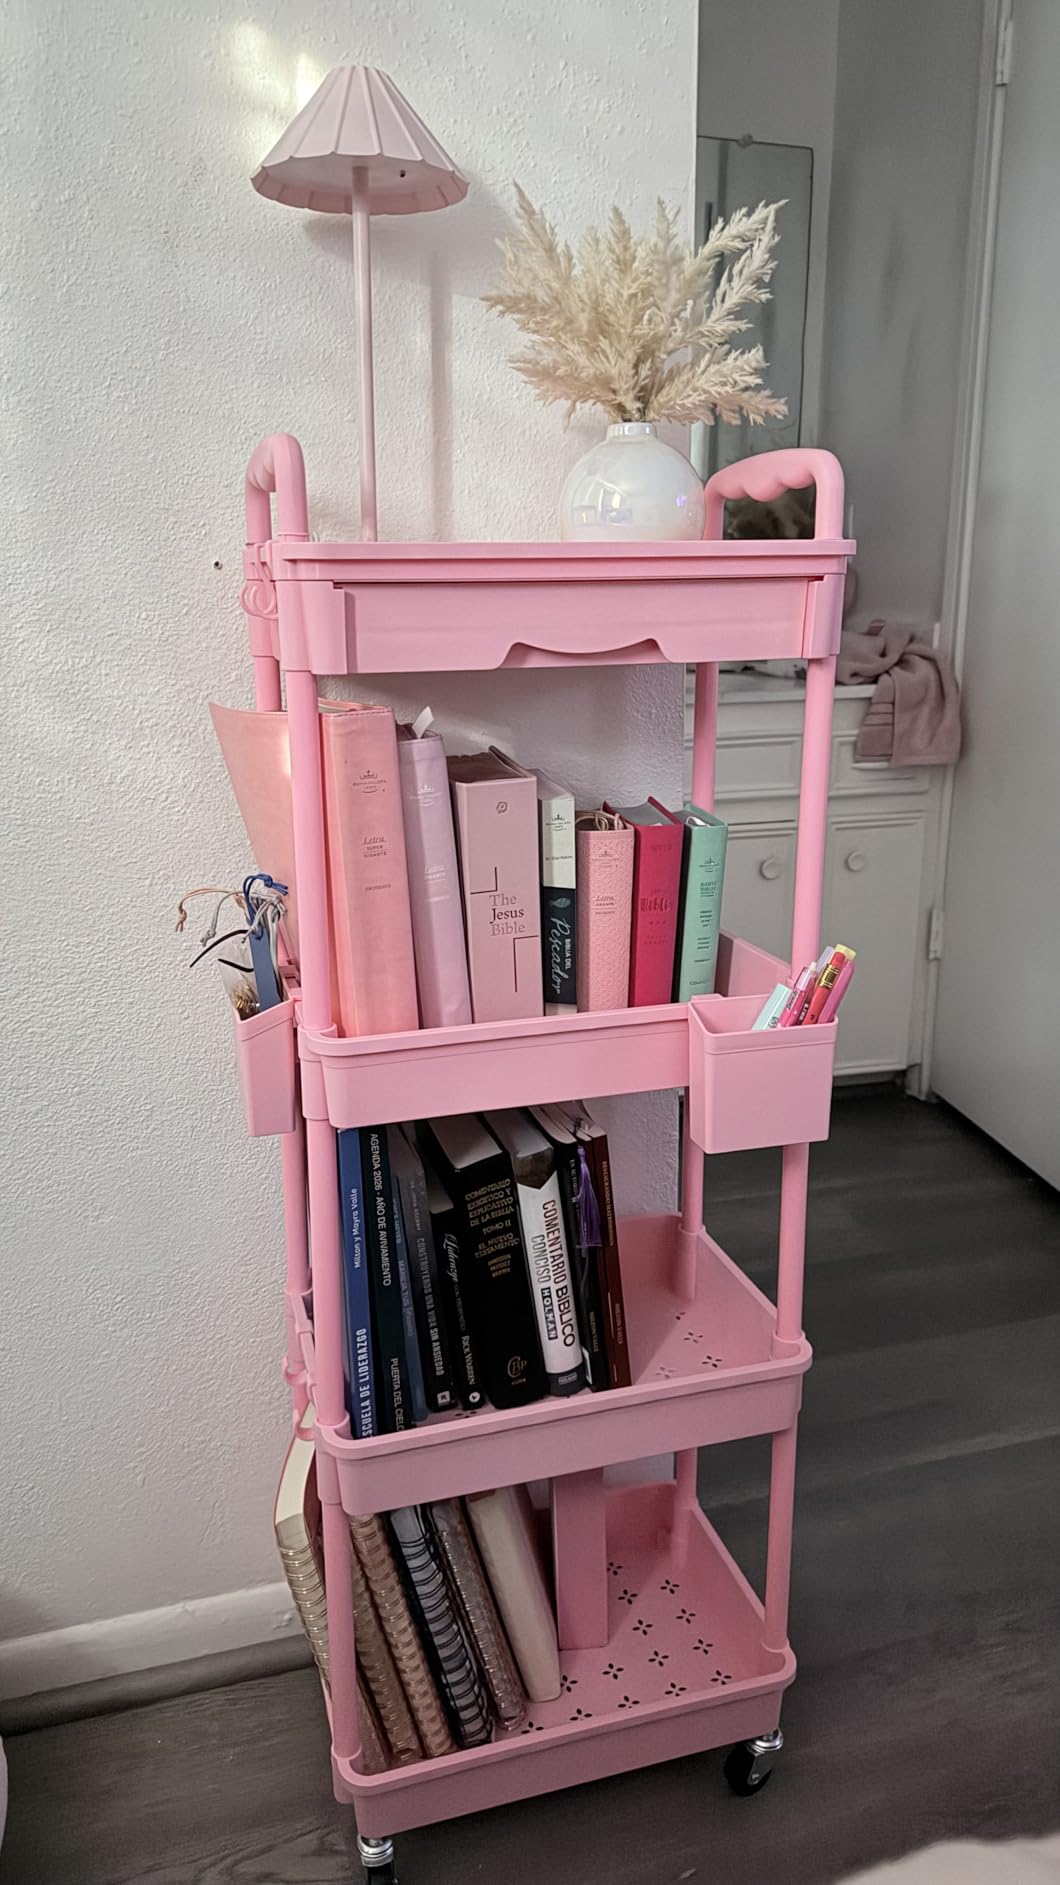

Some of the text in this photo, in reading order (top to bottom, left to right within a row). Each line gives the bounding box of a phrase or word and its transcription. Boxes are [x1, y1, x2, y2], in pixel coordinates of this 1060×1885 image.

[489, 893, 517, 906] The
[489, 908, 525, 924] Jesus
[490, 921, 526, 936] Bible
[549, 917, 571, 995] Pescador
[370, 1133, 381, 1170] AGENDA
[373, 1171, 382, 1190] 2026
[465, 1179, 511, 1201] COMENTARIO
[376, 1197, 386, 1216] AÑO
[469, 1196, 513, 1218] EXPLICATIVO
[352, 1210, 361, 1235] Mayra
[377, 1216, 387, 1229] DE
[470, 1219, 480, 1227] DE
[481, 1213, 491, 1222] LA
[482, 1219, 512, 1235] TOMO II
[474, 1237, 520, 1259] TESTAMENTO
[488, 1232, 514, 1245] NUEVO
[542, 1199, 567, 1284] COMENTARIO
[352, 1243, 361, 1268] Milton
[379, 1231, 391, 1286] AVIVAMIENTO
[416, 1237, 431, 1294] CONSTRUYENDO
[531, 1234, 558, 1340] CONCISO HOLMAN
[427, 1310, 437, 1327] VIDA
[430, 1327, 439, 1341] SIN
[432, 1341, 444, 1376] ANSIEDAD
[462, 1335, 475, 1385] RICK WARREN
[356, 1328, 373, 1438] SCUELA DE LIDERAZGO
[390, 1358, 401, 1390] PUERTA
[393, 1391, 402, 1407] DEL
